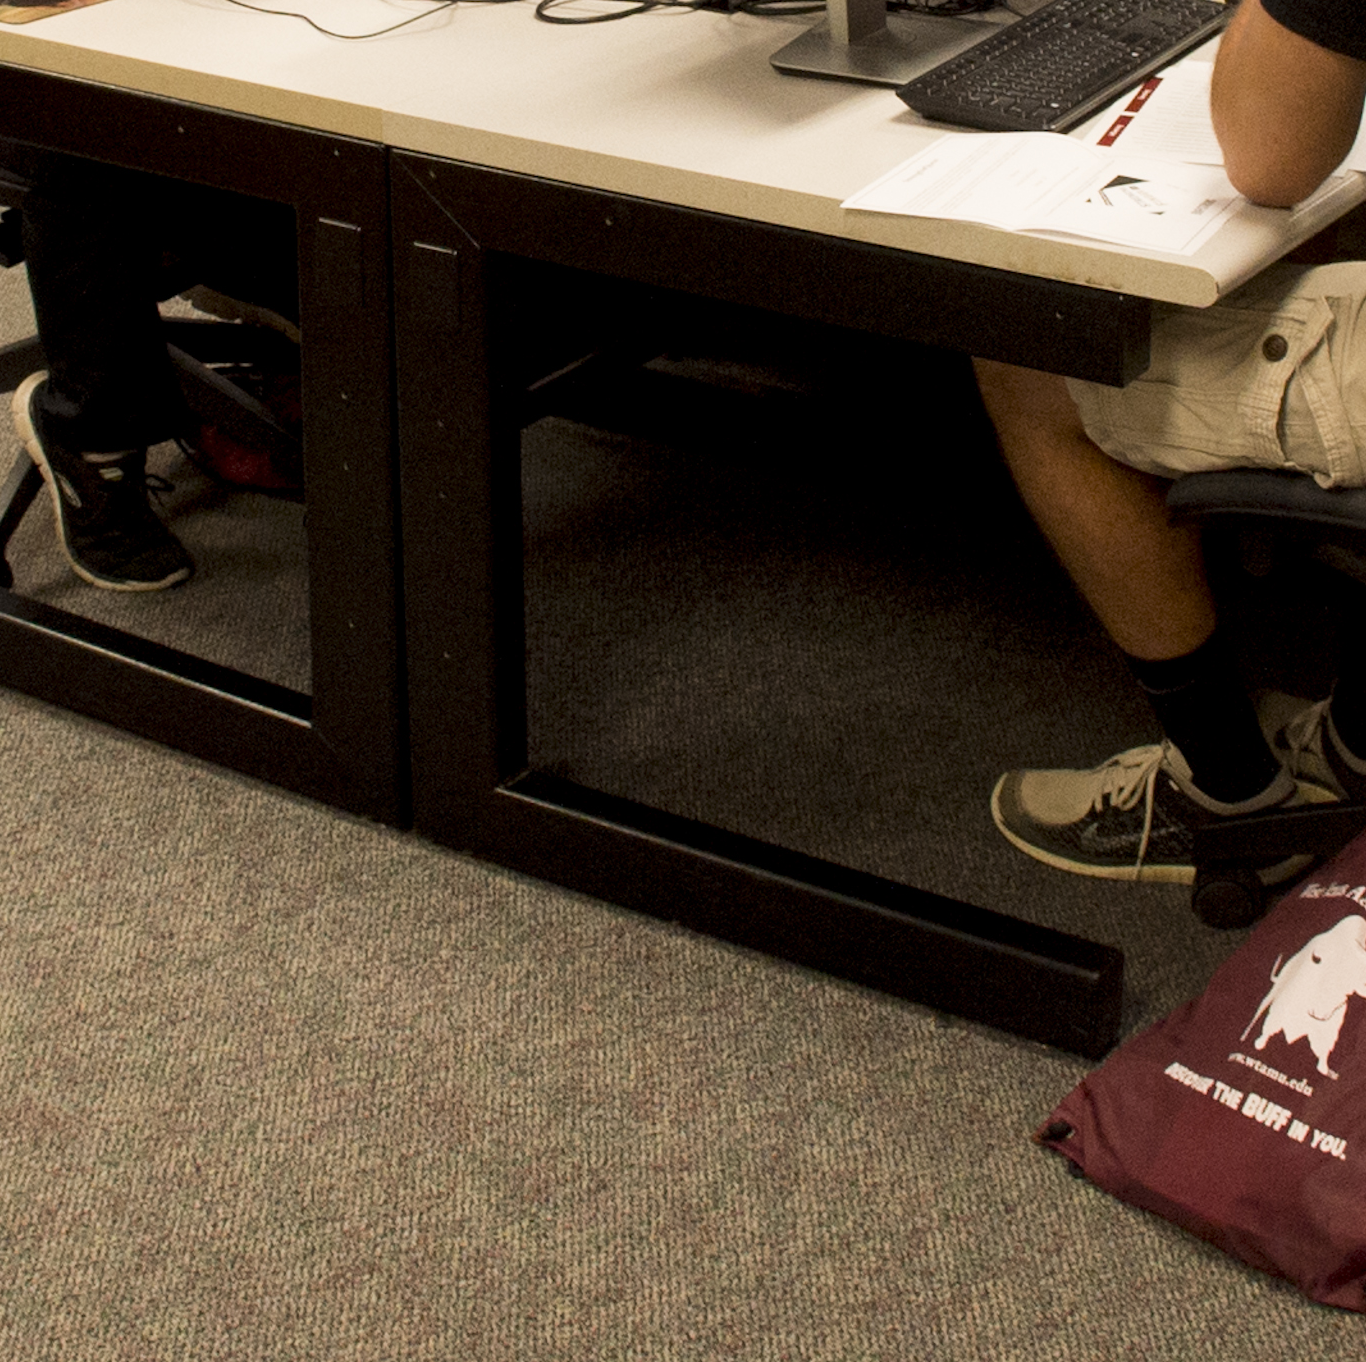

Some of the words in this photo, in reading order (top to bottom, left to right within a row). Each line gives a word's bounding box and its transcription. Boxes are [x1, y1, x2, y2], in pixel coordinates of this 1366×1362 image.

[1212, 1080, 1244, 1111] THE
[1241, 1092, 1292, 1131] BUFF
[1287, 1119, 1310, 1143] IN
[1311, 1129, 1347, 1161] YOU.
